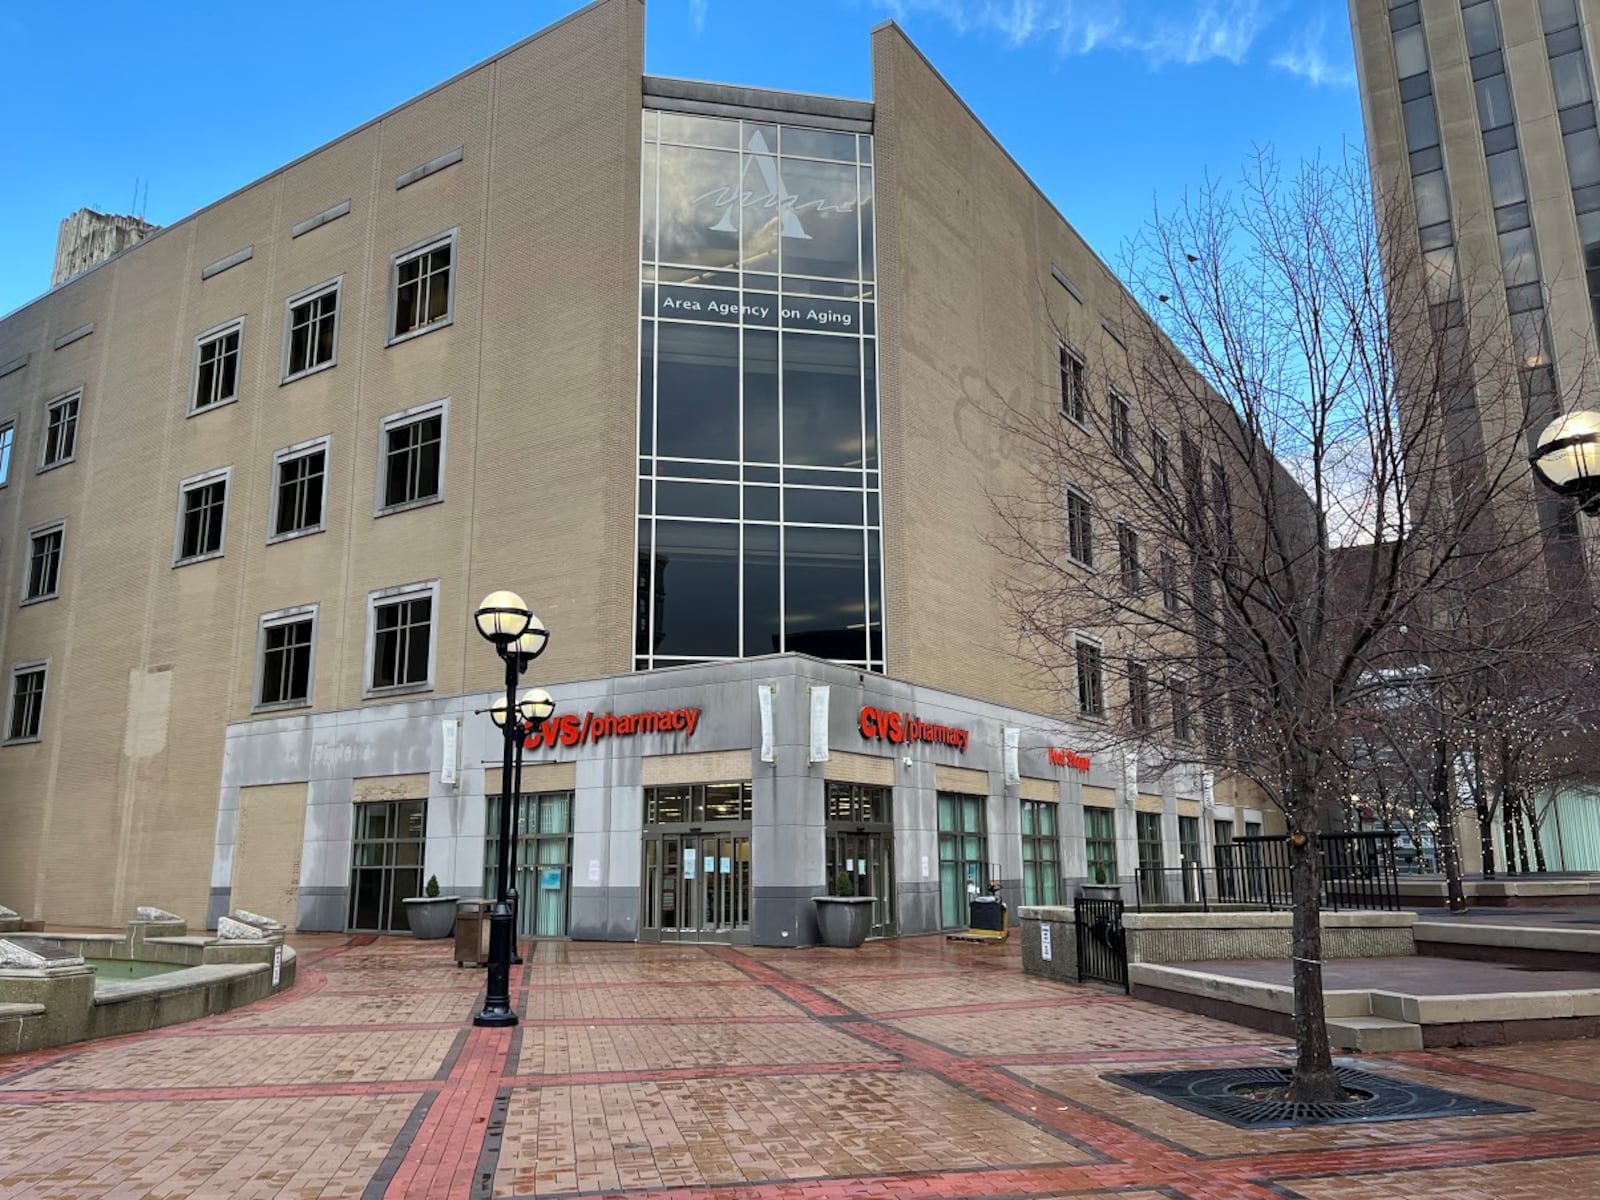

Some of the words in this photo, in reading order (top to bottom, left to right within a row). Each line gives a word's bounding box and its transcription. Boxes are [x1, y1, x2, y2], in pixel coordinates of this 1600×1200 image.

[663, 297, 702, 311] Area
[707, 301, 769, 318] Agency
[781, 308, 800, 319] on
[806, 309, 852, 326] Aging
[860, 705, 969, 752] CVS/pharmacy
